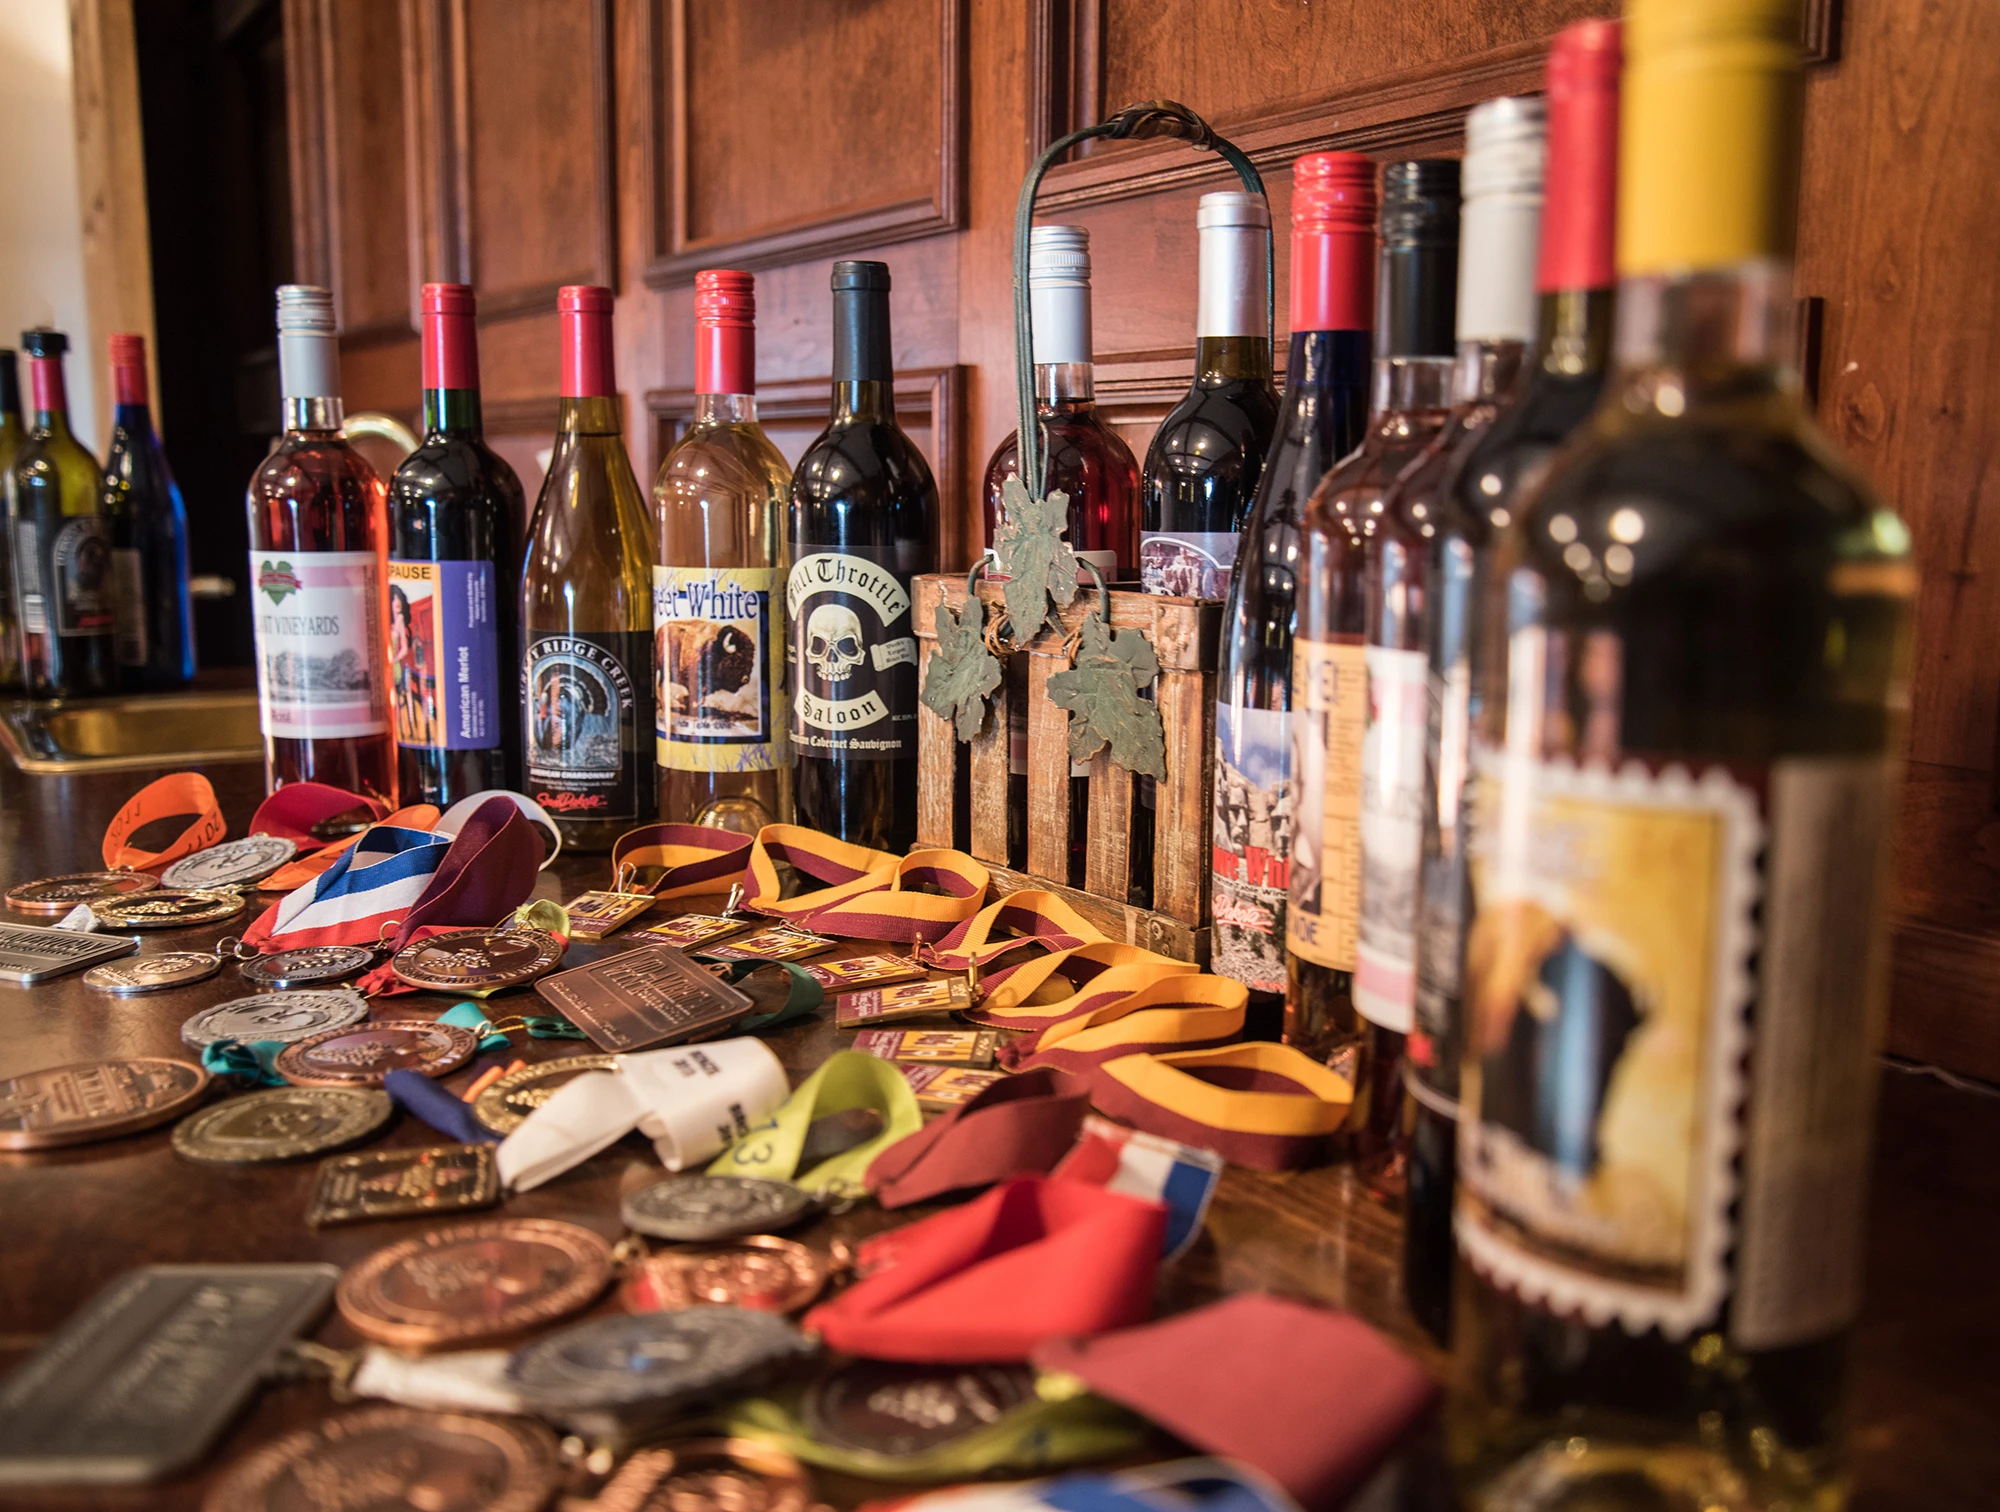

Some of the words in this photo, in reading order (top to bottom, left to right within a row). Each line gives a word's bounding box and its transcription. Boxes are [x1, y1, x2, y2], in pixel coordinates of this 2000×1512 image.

[686, 578, 760, 620] White
[789, 565, 813, 609] Full
[815, 557, 905, 615] Throttle
[274, 614, 340, 637] VINEYARDS
[457, 645, 470, 683] Merlot
[541, 639, 599, 661] RIDGE
[600, 656, 634, 710] CREEK
[459, 684, 471, 738] American
[802, 693, 877, 725] Saloon
[810, 734, 848, 750] Cabernet
[848, 737, 902, 752] Sauvignon
[561, 771, 616, 780] CHARDONNAY
[1243, 844, 1290, 890] Whi
